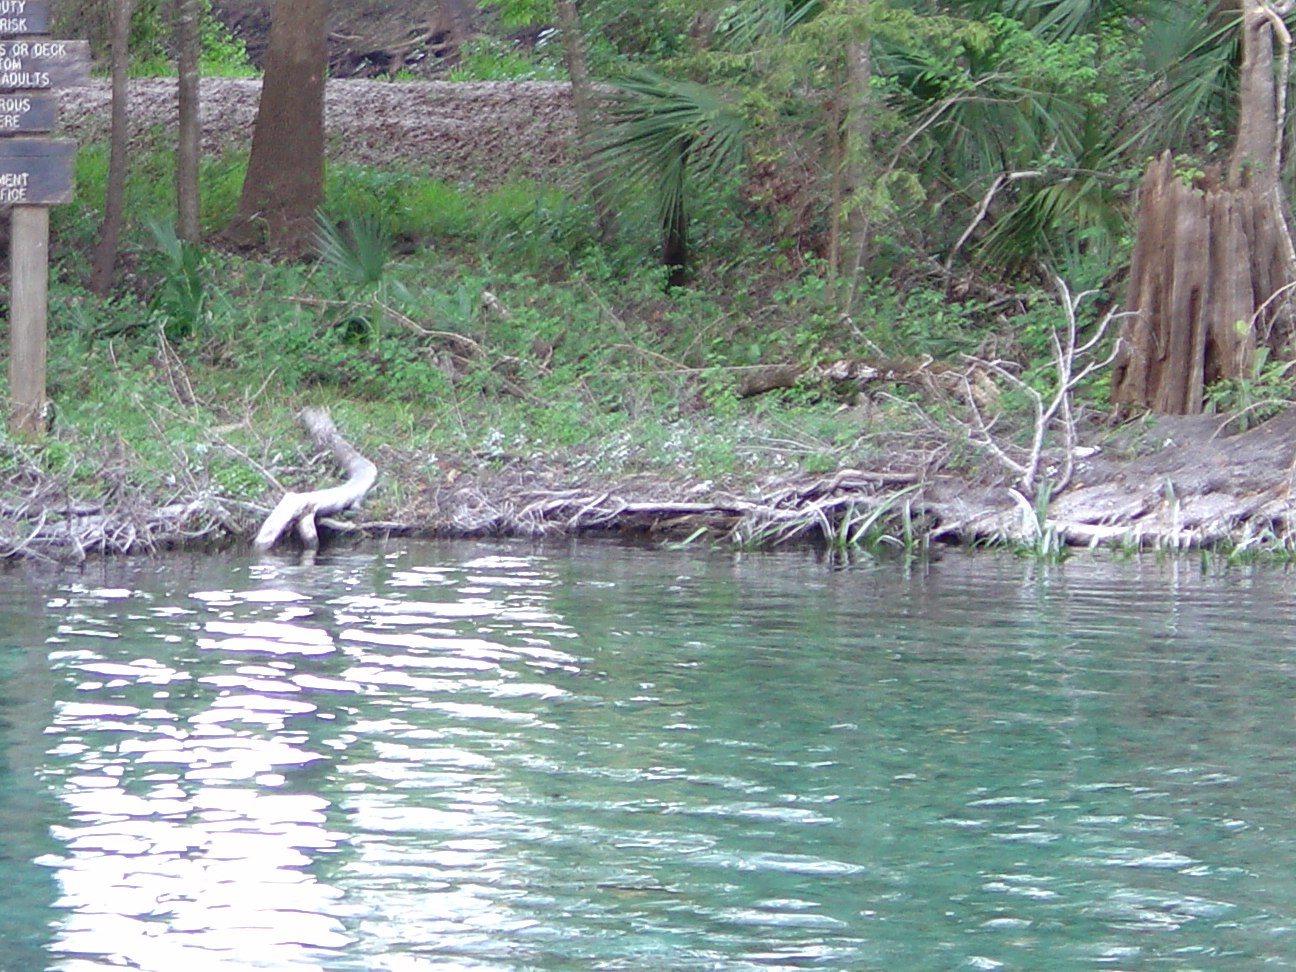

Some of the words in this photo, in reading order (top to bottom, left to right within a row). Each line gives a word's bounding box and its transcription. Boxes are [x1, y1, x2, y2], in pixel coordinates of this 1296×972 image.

[0, 19, 27, 30] RISK
[13, 44, 29, 56] OR
[35, 43, 66, 56] DECK
